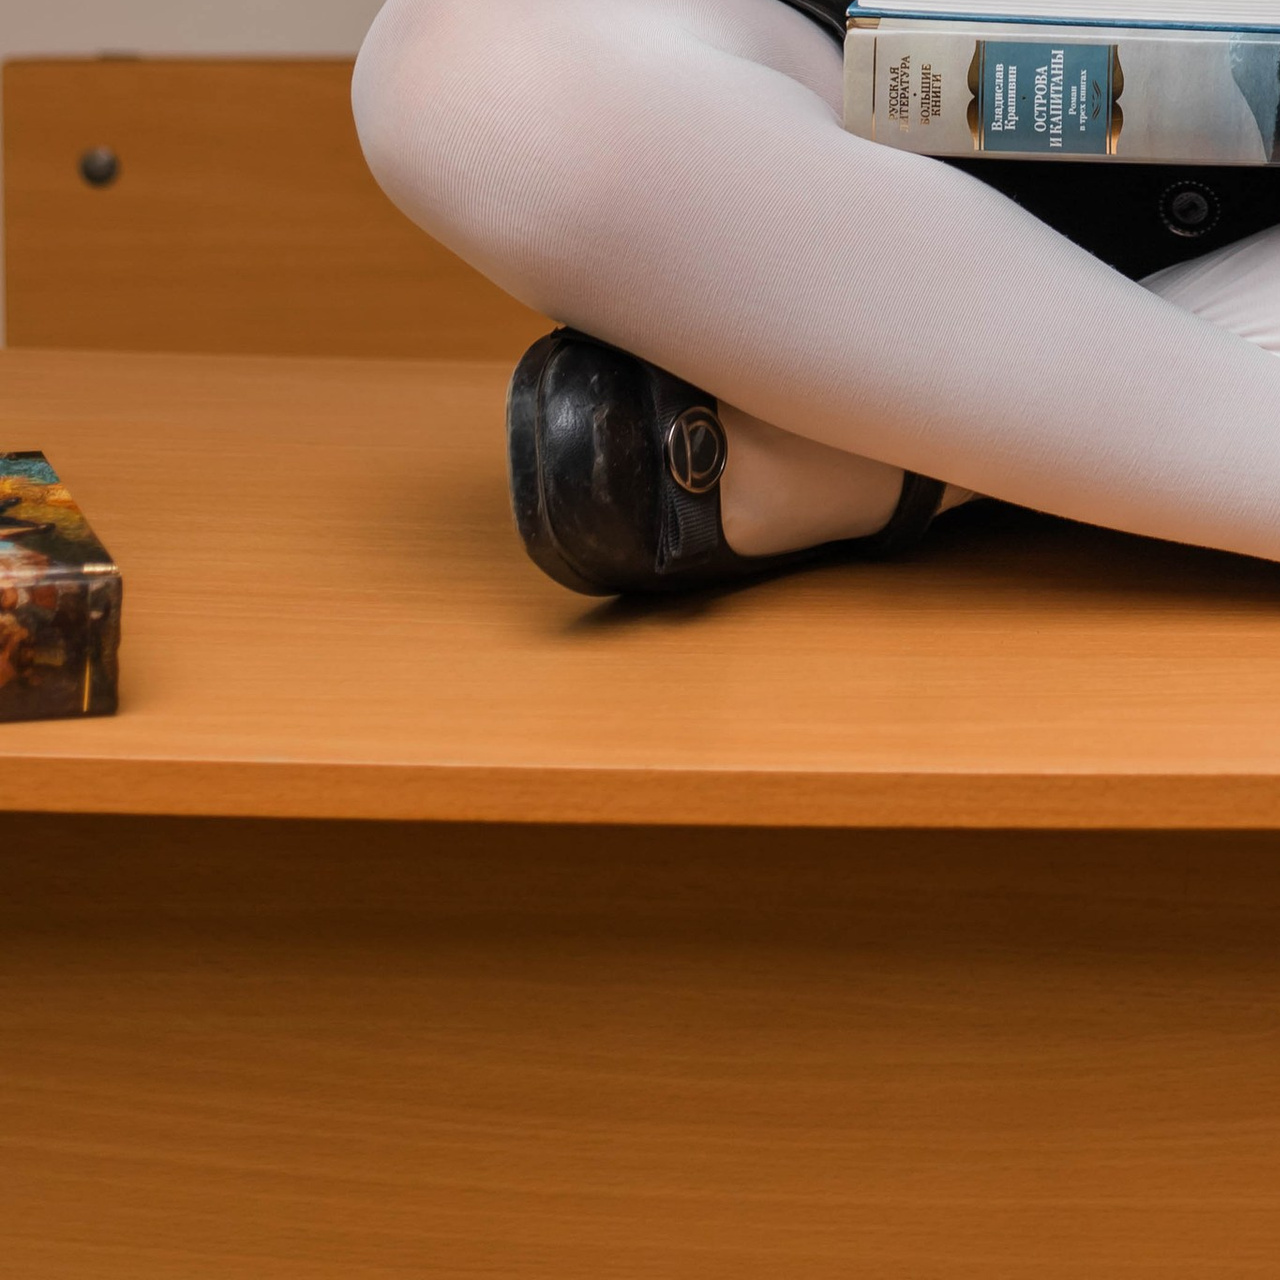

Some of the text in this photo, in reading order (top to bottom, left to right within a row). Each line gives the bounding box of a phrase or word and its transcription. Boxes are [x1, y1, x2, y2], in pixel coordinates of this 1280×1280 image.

[888, 67, 900, 121] РУССКАЯ
[899, 55, 911, 133] ЛИТЕРАТУРА
[920, 64, 932, 125] БОЛЬШИЕ
[931, 74, 942, 117] КНИГИ
[991, 63, 1004, 132] Владислав
[1004, 65, 1019, 131] Крапивин
[1034, 65, 1048, 133] ОСТРОВА
[1049, 49, 1064, 148] И КАПИТАНЫ
[1068, 85, 1077, 116] Роман
[1079, 103, 1088, 125] трех
